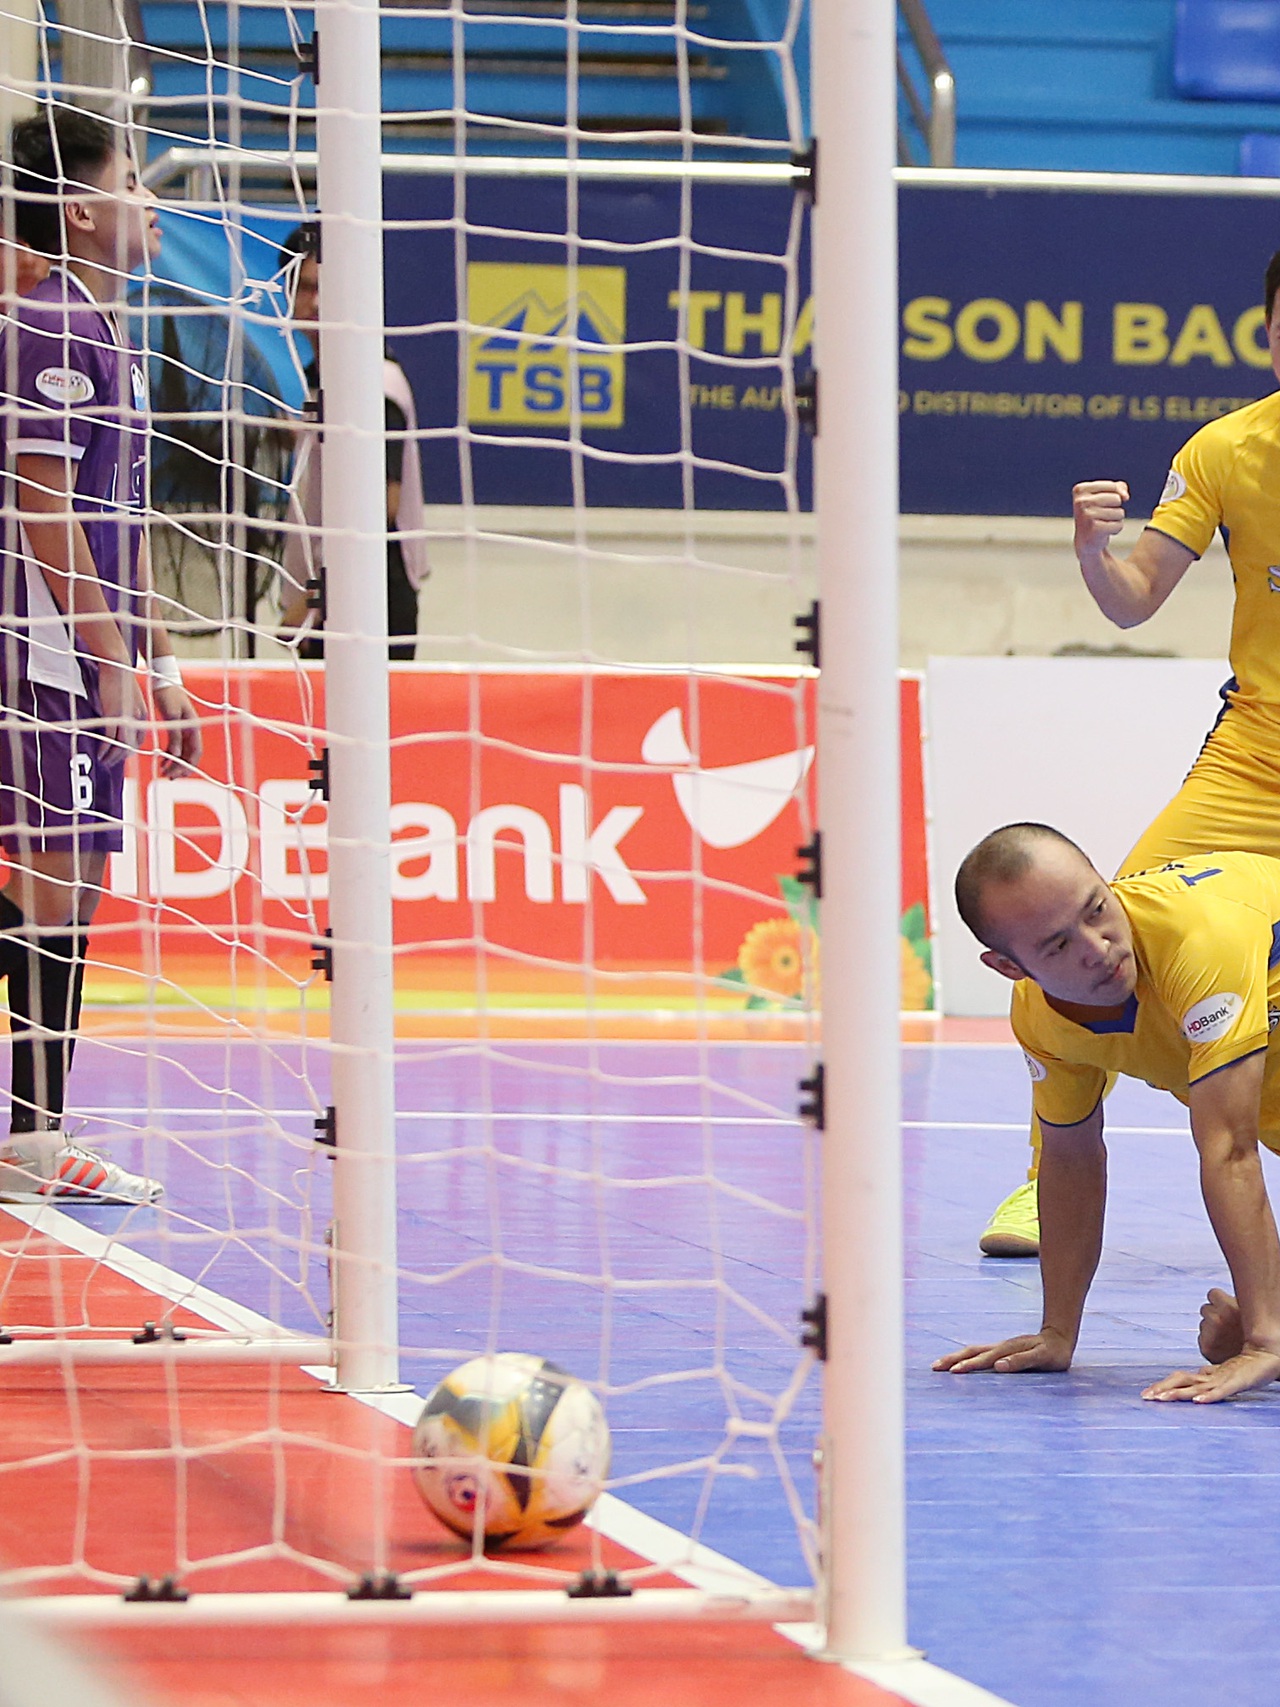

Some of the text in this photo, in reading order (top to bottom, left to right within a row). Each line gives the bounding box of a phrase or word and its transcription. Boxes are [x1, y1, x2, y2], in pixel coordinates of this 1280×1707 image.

[902, 296, 1084, 363] SON
[475, 361, 613, 414] TSB
[913, 391, 1083, 419] DISTRIBUTOR
[1087, 395, 1124, 420] OF
[1128, 397, 1160, 421] LS
[70, 753, 93, 809] 6
[1186, 1006, 1230, 1034] HDBank
